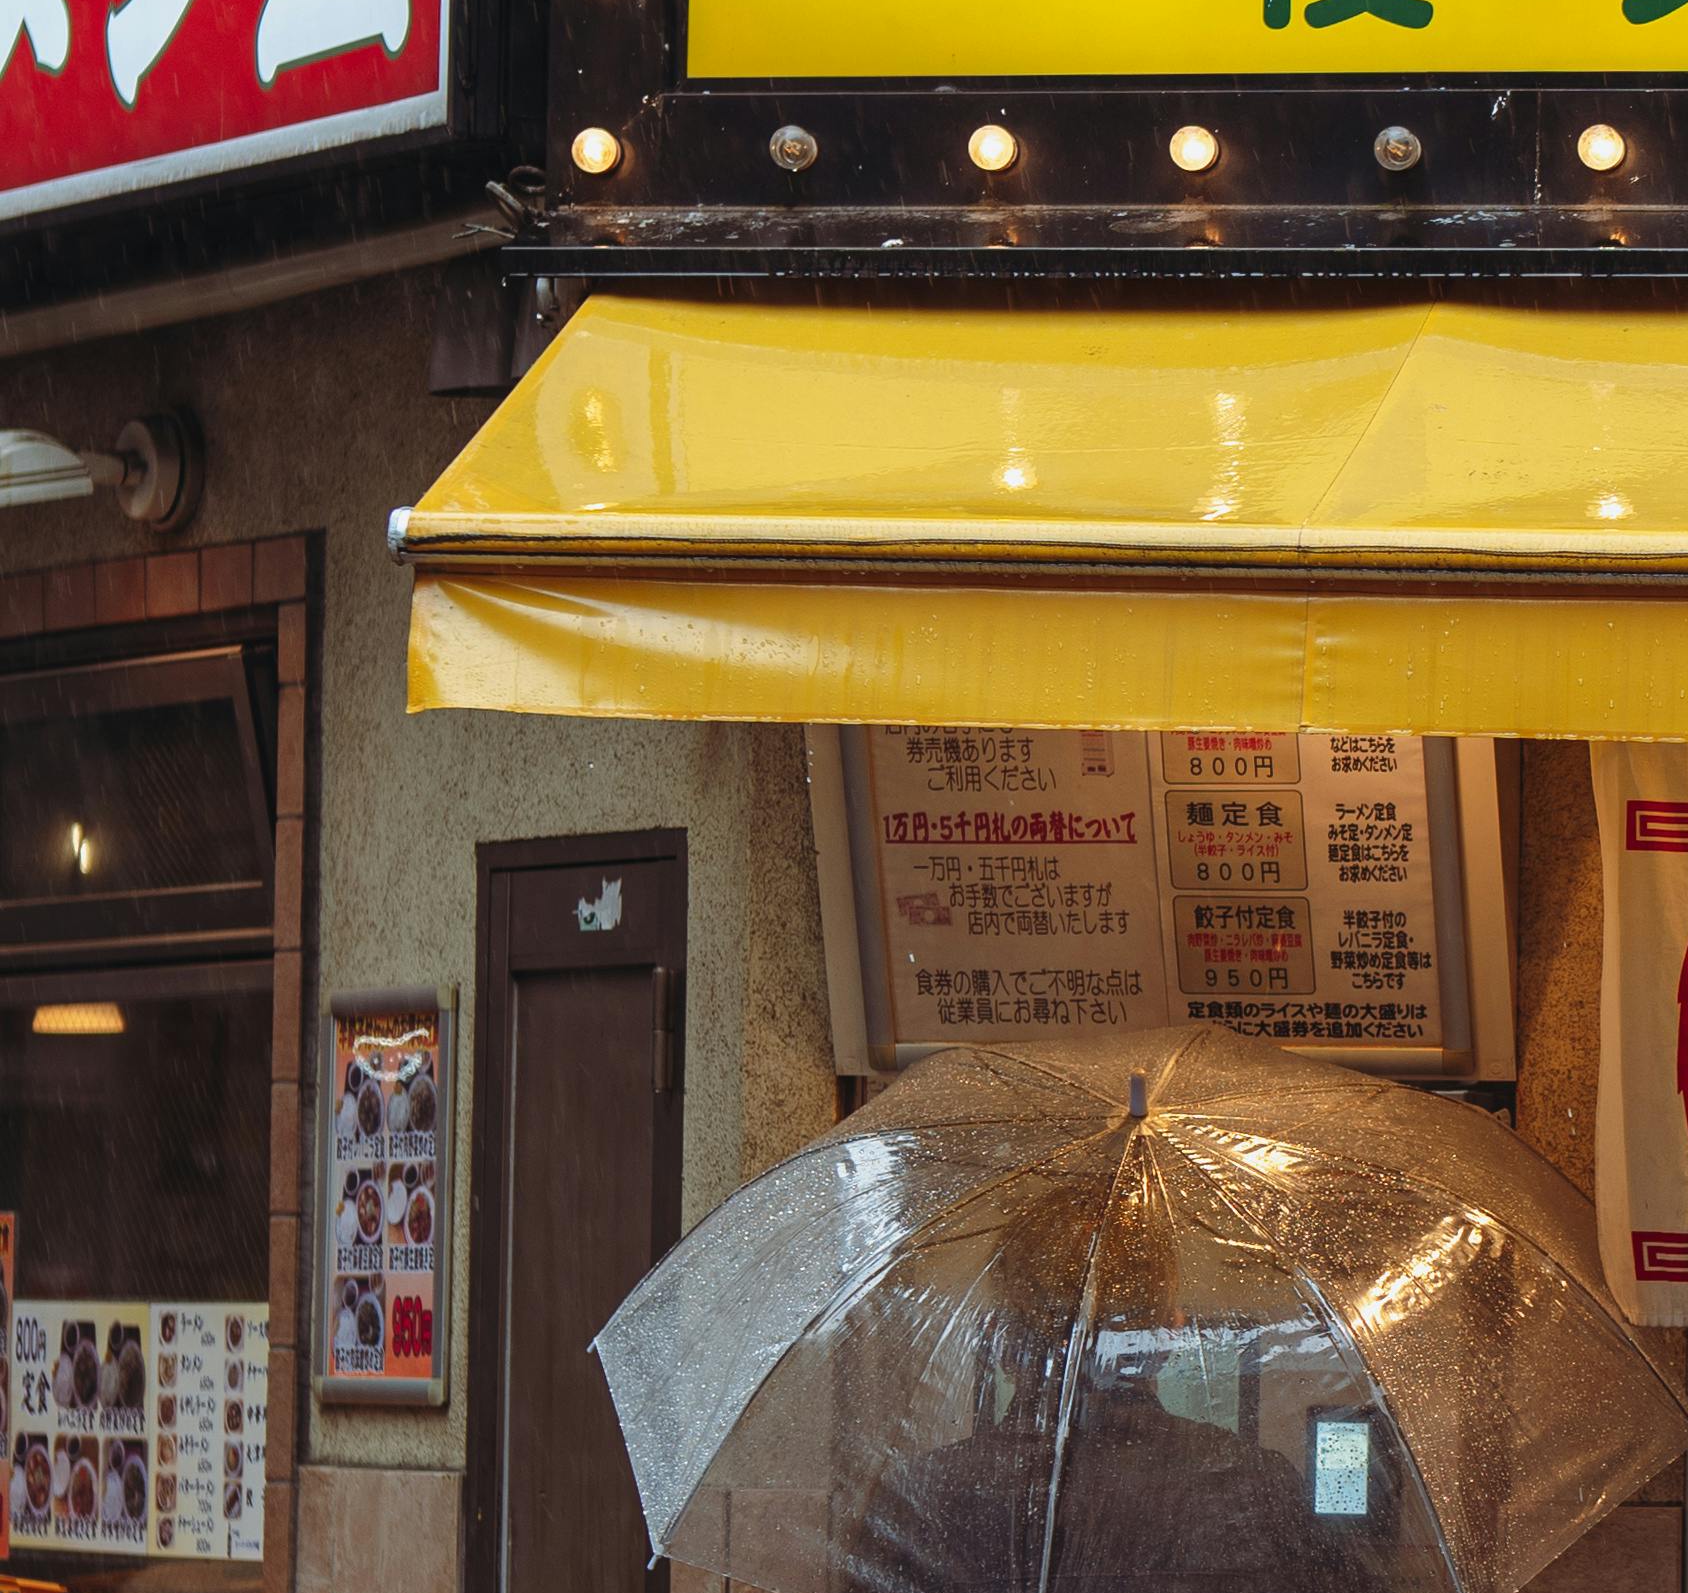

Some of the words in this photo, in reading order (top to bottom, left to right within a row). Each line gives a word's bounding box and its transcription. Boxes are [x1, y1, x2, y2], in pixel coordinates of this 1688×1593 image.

[907, 737, 1034, 763] 券売機あります
[1330, 736, 1396, 754] などはこちらを
[1331, 755, 1398, 774] お求めください
[927, 765, 1057, 792] ご利用ください
[1185, 801, 1283, 827] 麺定食
[1335, 802, 1397, 822] ラーメン定食
[1327, 843, 1410, 863] 麺定食はこちらを
[913, 856, 1061, 882] 一万円・五千円札は
[1338, 864, 1408, 883] お求めください
[949, 882, 1112, 909] お手数でございますが
[967, 910, 1130, 936] 店内で両替いたします
[1193, 904, 1297, 929] 餃子付定食
[914, 968, 1143, 996] 食券の購入でご不明な点は
[1351, 971, 1406, 991] こちらです
[937, 998, 1128, 1025] 従業員にお尋ね下さい
[1187, 1001, 1428, 1021] 定食類のライスや麺の大盛りは
[1212, 1019, 1424, 1039] に大盛券を追加ください
